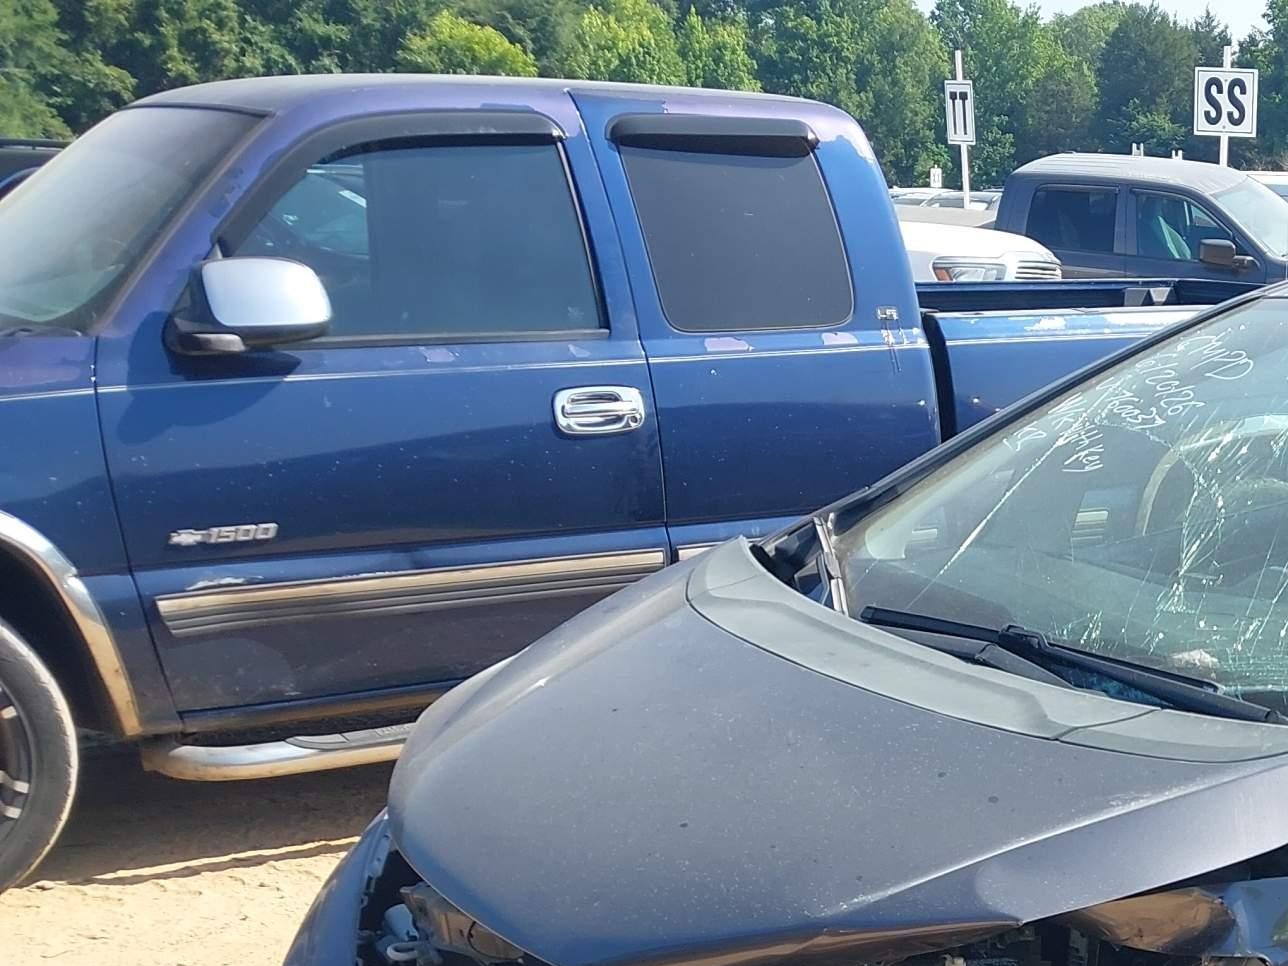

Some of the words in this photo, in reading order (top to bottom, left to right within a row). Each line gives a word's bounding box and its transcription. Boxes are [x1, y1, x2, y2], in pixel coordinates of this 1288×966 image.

[949, 91, 968, 135] TT
[1203, 77, 1247, 126] SS
[208, 522, 280, 544] 1500
